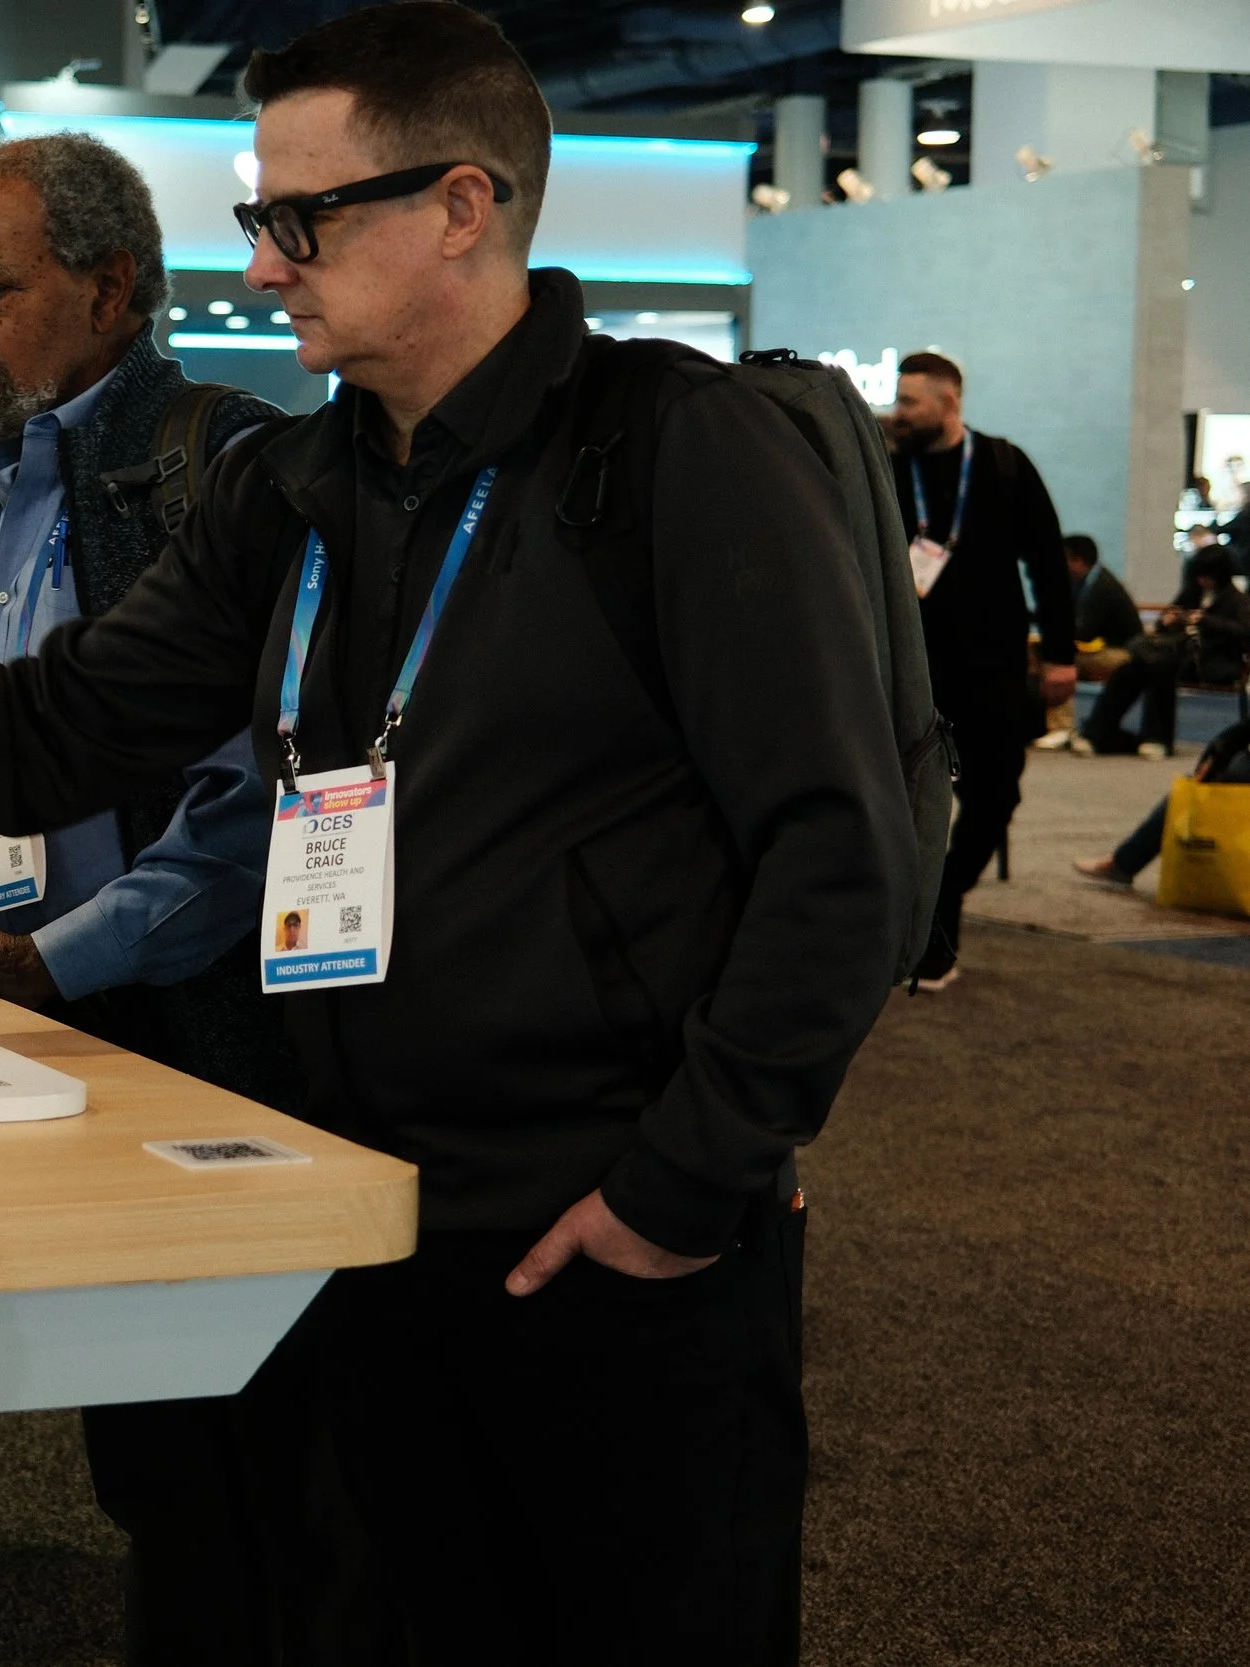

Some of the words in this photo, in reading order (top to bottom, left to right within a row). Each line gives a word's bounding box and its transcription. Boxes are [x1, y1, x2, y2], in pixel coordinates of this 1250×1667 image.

[463, 466, 498, 534] AFEELA
[307, 558, 325, 590] Sony
[323, 798, 350, 810] show
[350, 796, 362, 808] up
[320, 814, 353, 832] CES
[305, 837, 347, 855] BRUCE
[305, 853, 344, 870] CRAIG
[282, 871, 322, 884] PROVIDENCE
[323, 868, 348, 879] HEALTH
[349, 866, 365, 875] AND
[307, 880, 337, 892] SERVICES
[332, 892, 346, 902] WA
[276, 962, 320, 976] INDUSTRY
[320, 957, 366, 972] ATTENDEE
